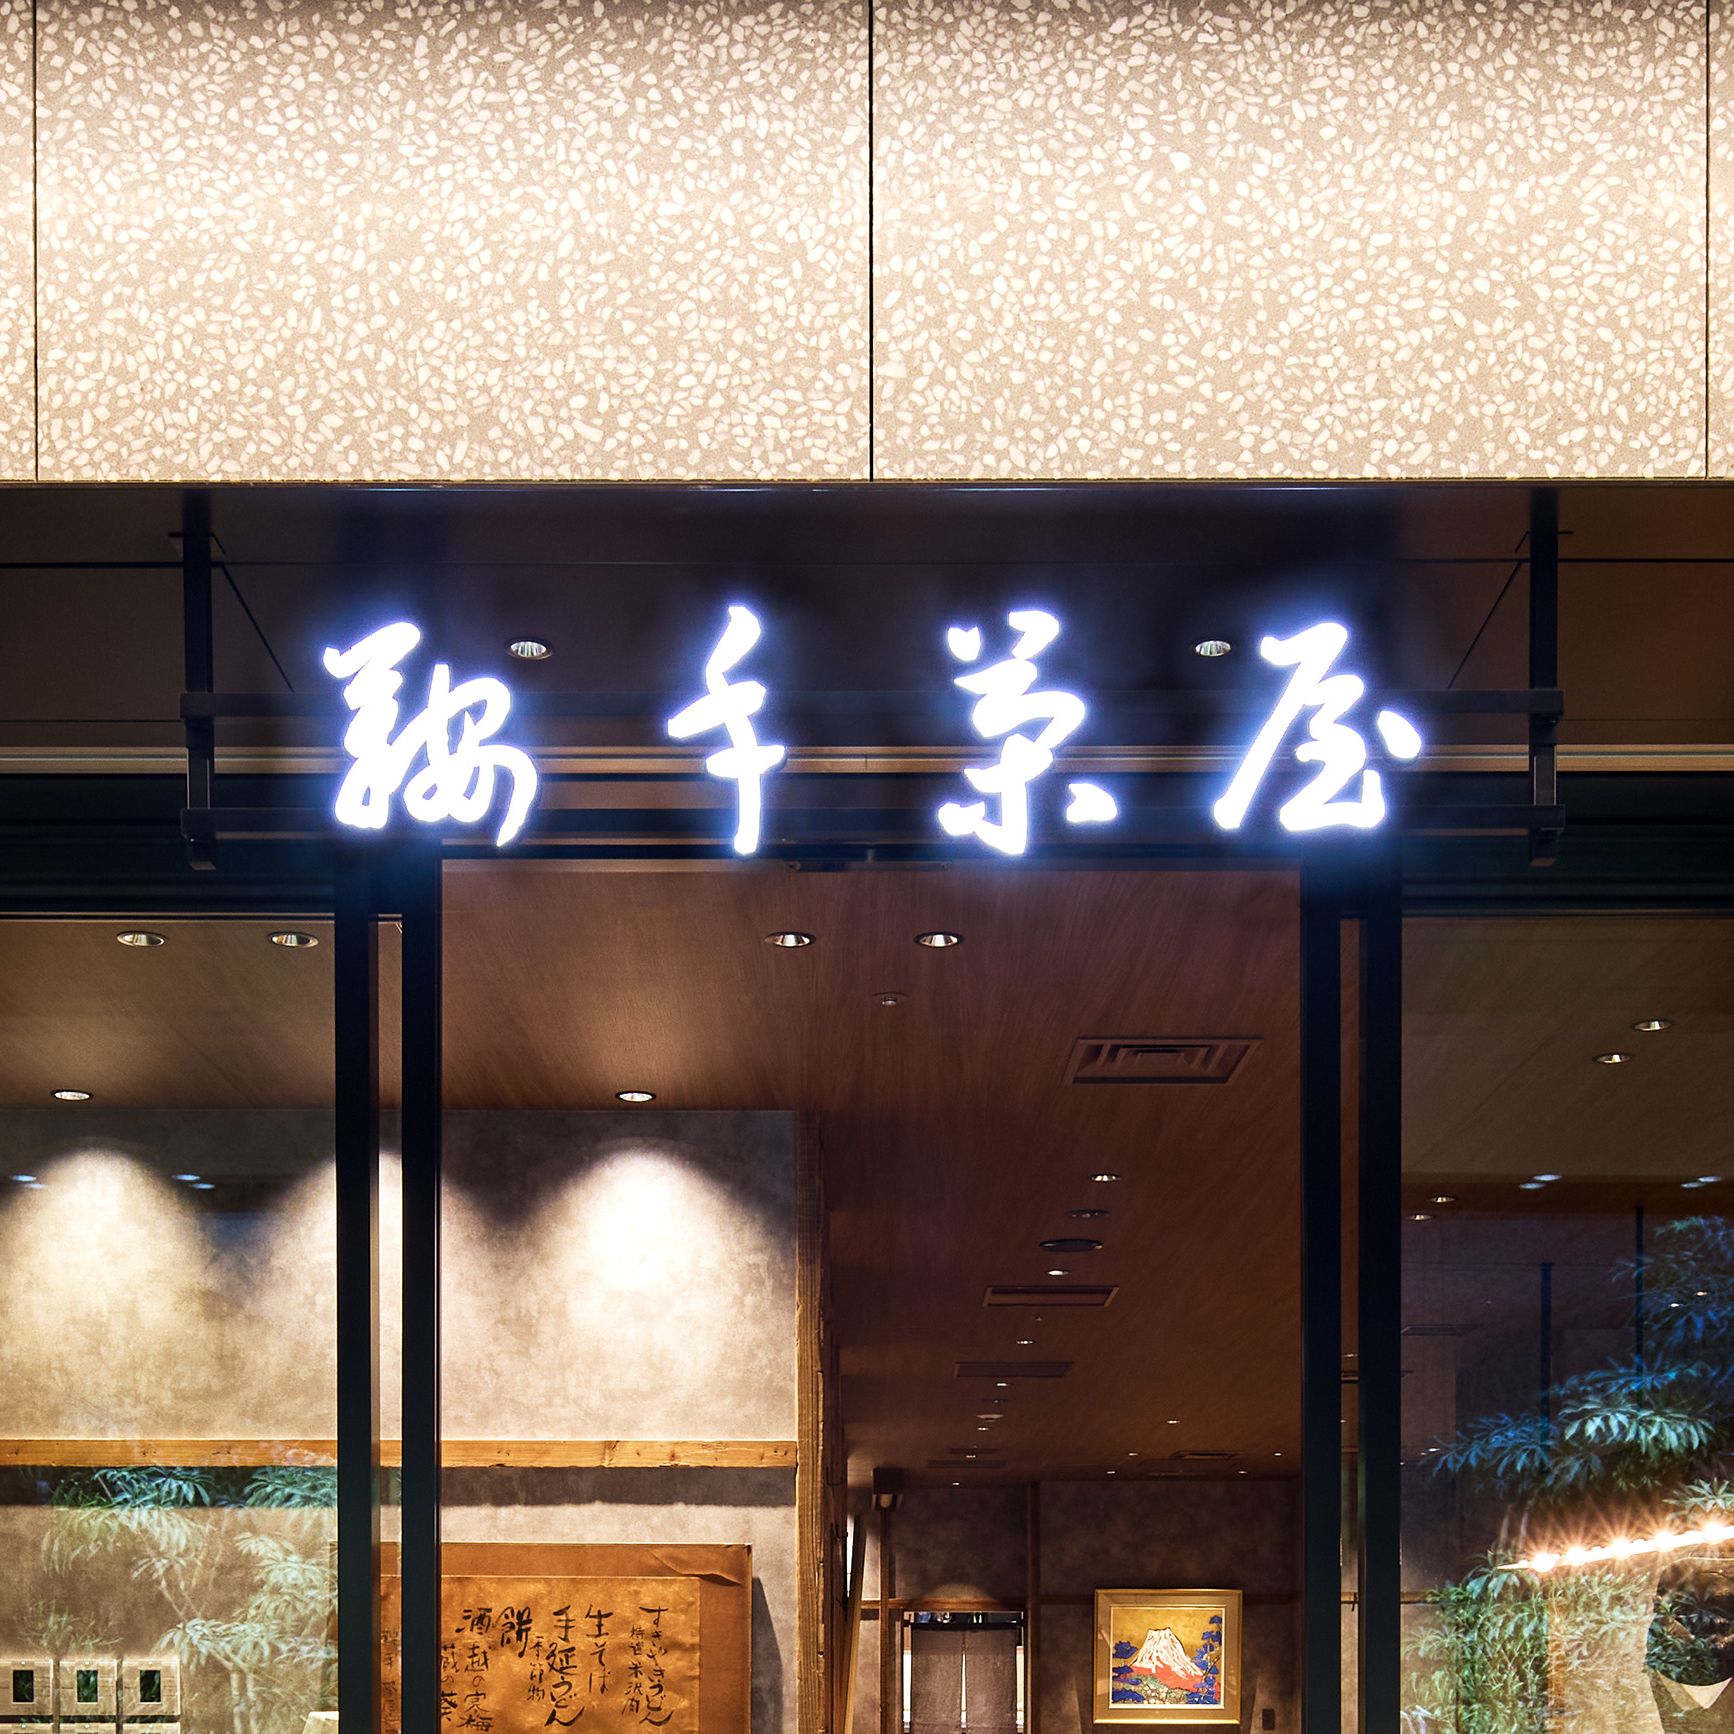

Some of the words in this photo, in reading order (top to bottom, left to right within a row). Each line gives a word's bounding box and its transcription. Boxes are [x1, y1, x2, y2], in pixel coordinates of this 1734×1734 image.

[455, 1607, 492, 1635] 酒
[544, 1604, 585, 1727] 手延うどん
[584, 1604, 614, 1695] 生そば
